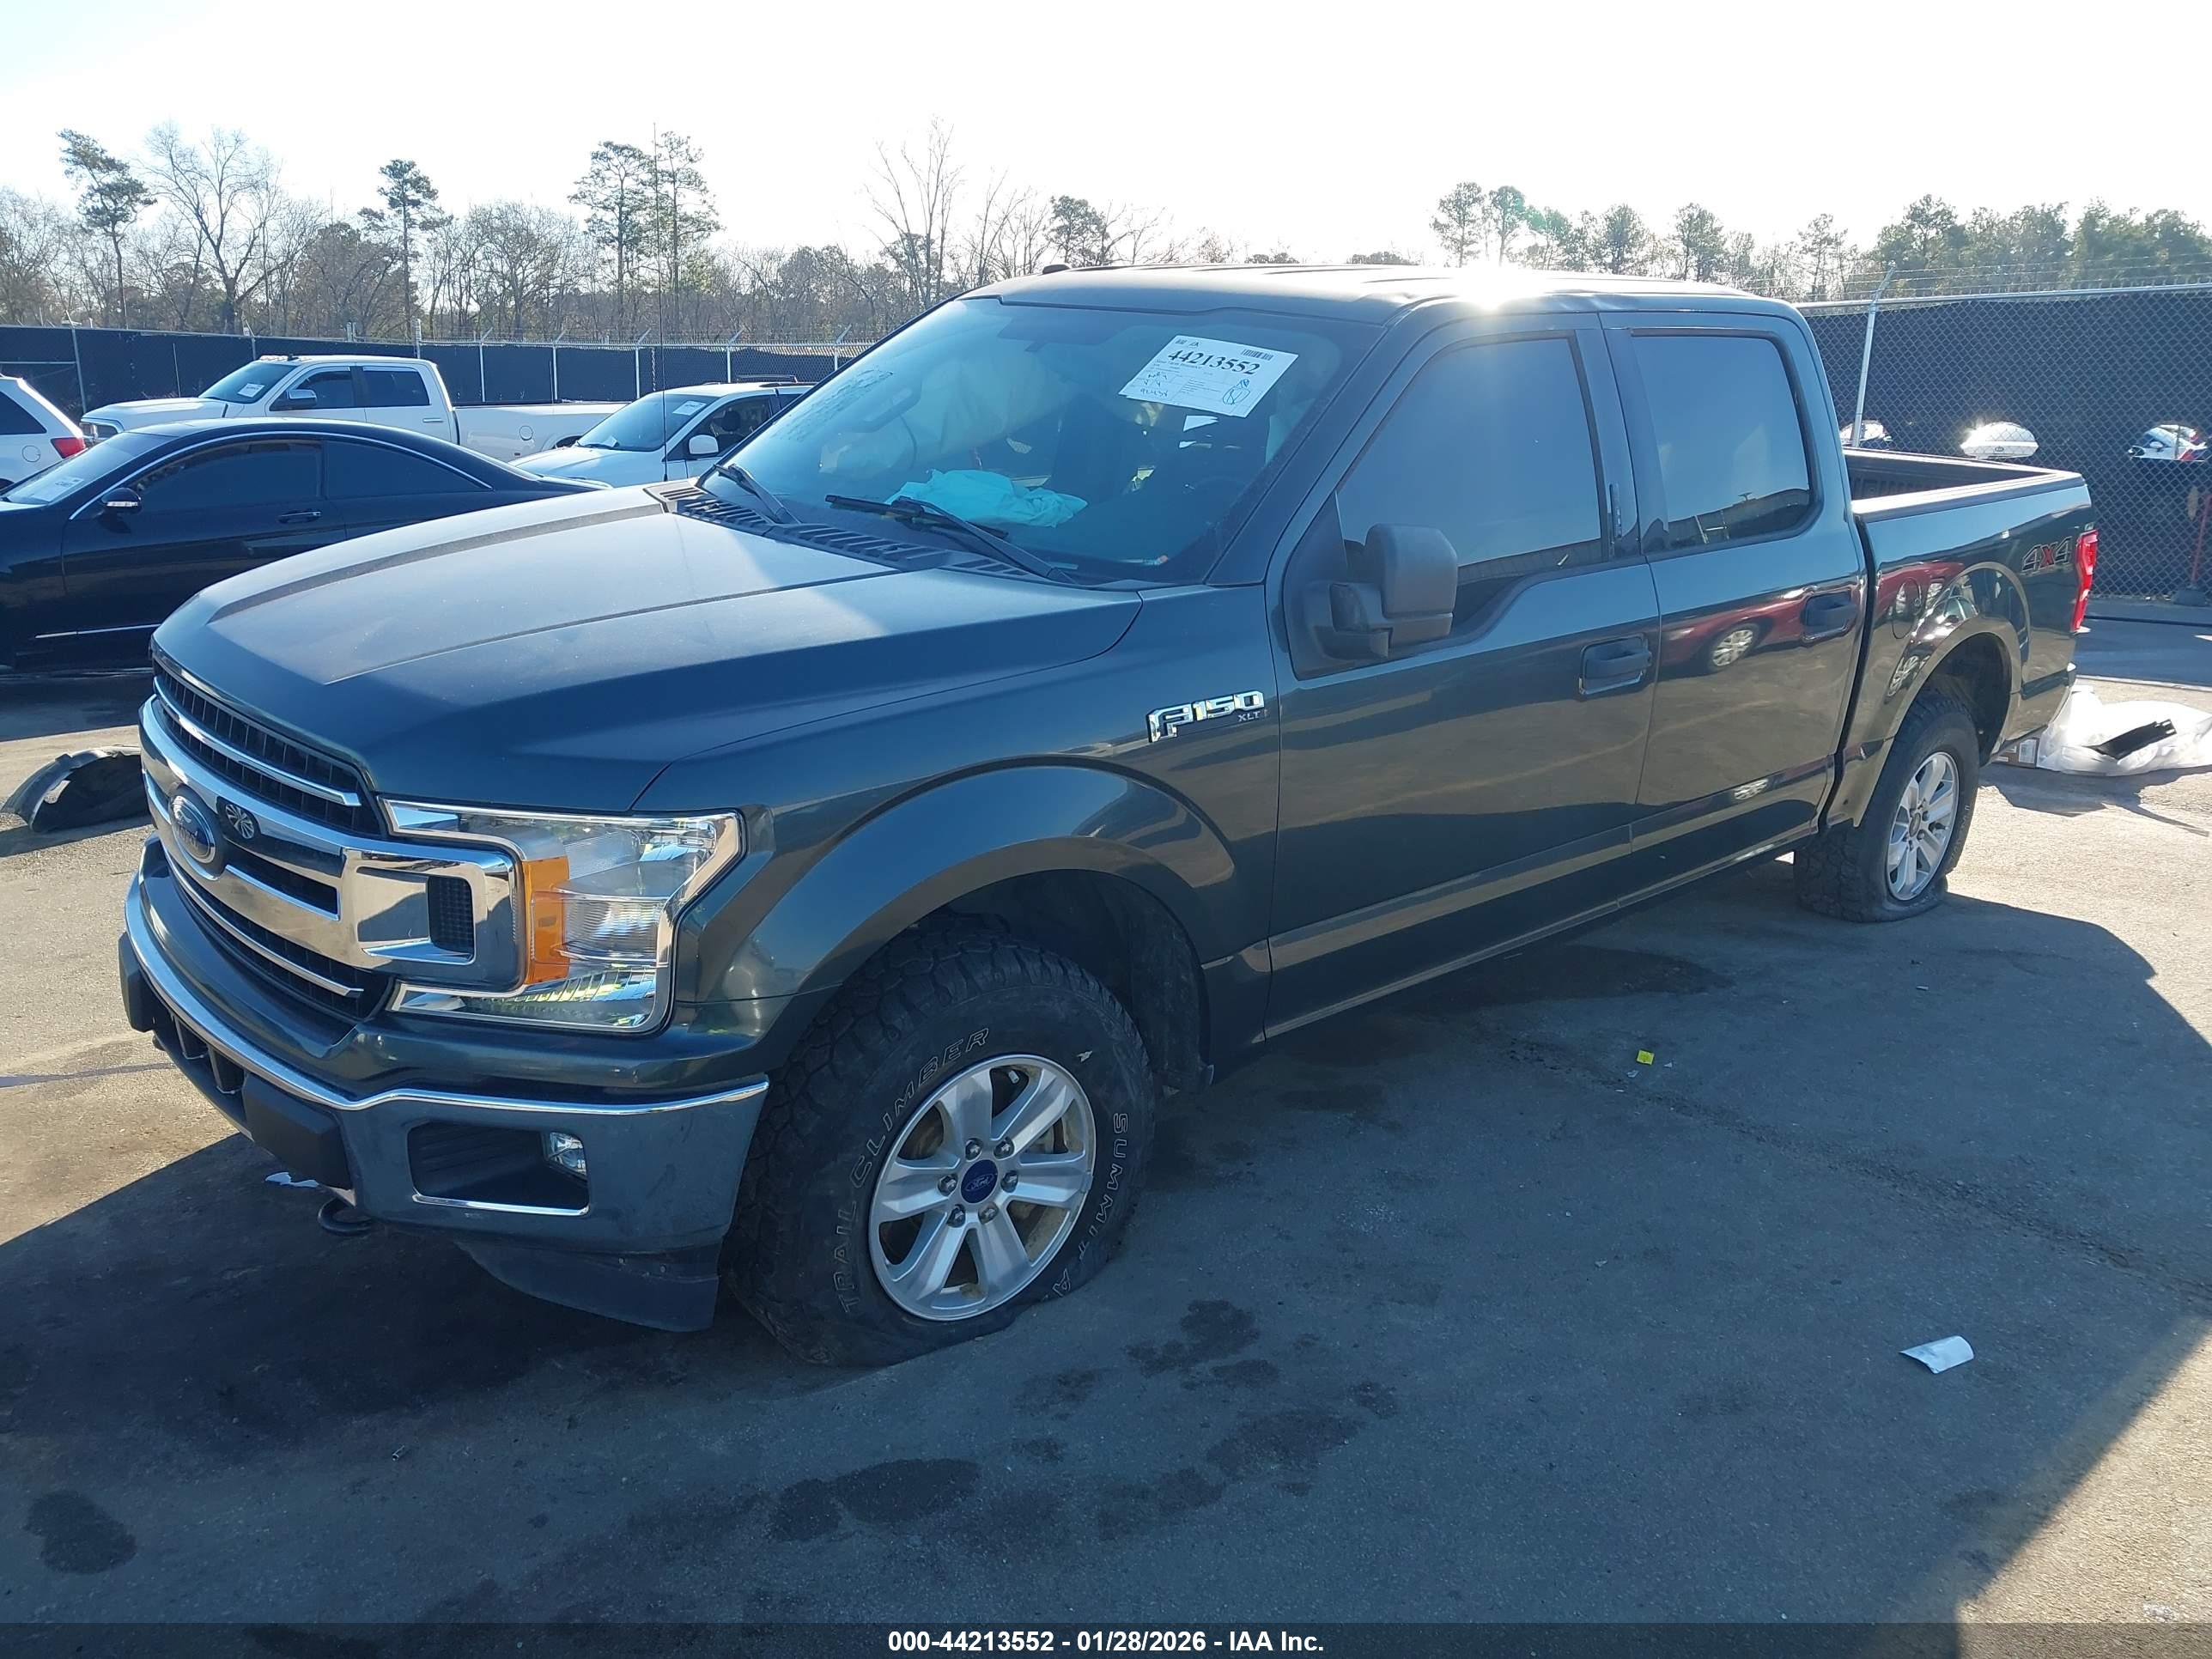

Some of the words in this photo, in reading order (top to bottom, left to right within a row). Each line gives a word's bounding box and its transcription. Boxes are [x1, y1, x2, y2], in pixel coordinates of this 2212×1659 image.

[1168, 349, 1261, 375] 44213552
[1237, 710, 1261, 722] XLT
[833, 1200, 860, 1313] TRAIL
[849, 1027, 989, 1188] CLIMBER
[1078, 1112, 1128, 1261] SUMMIT
